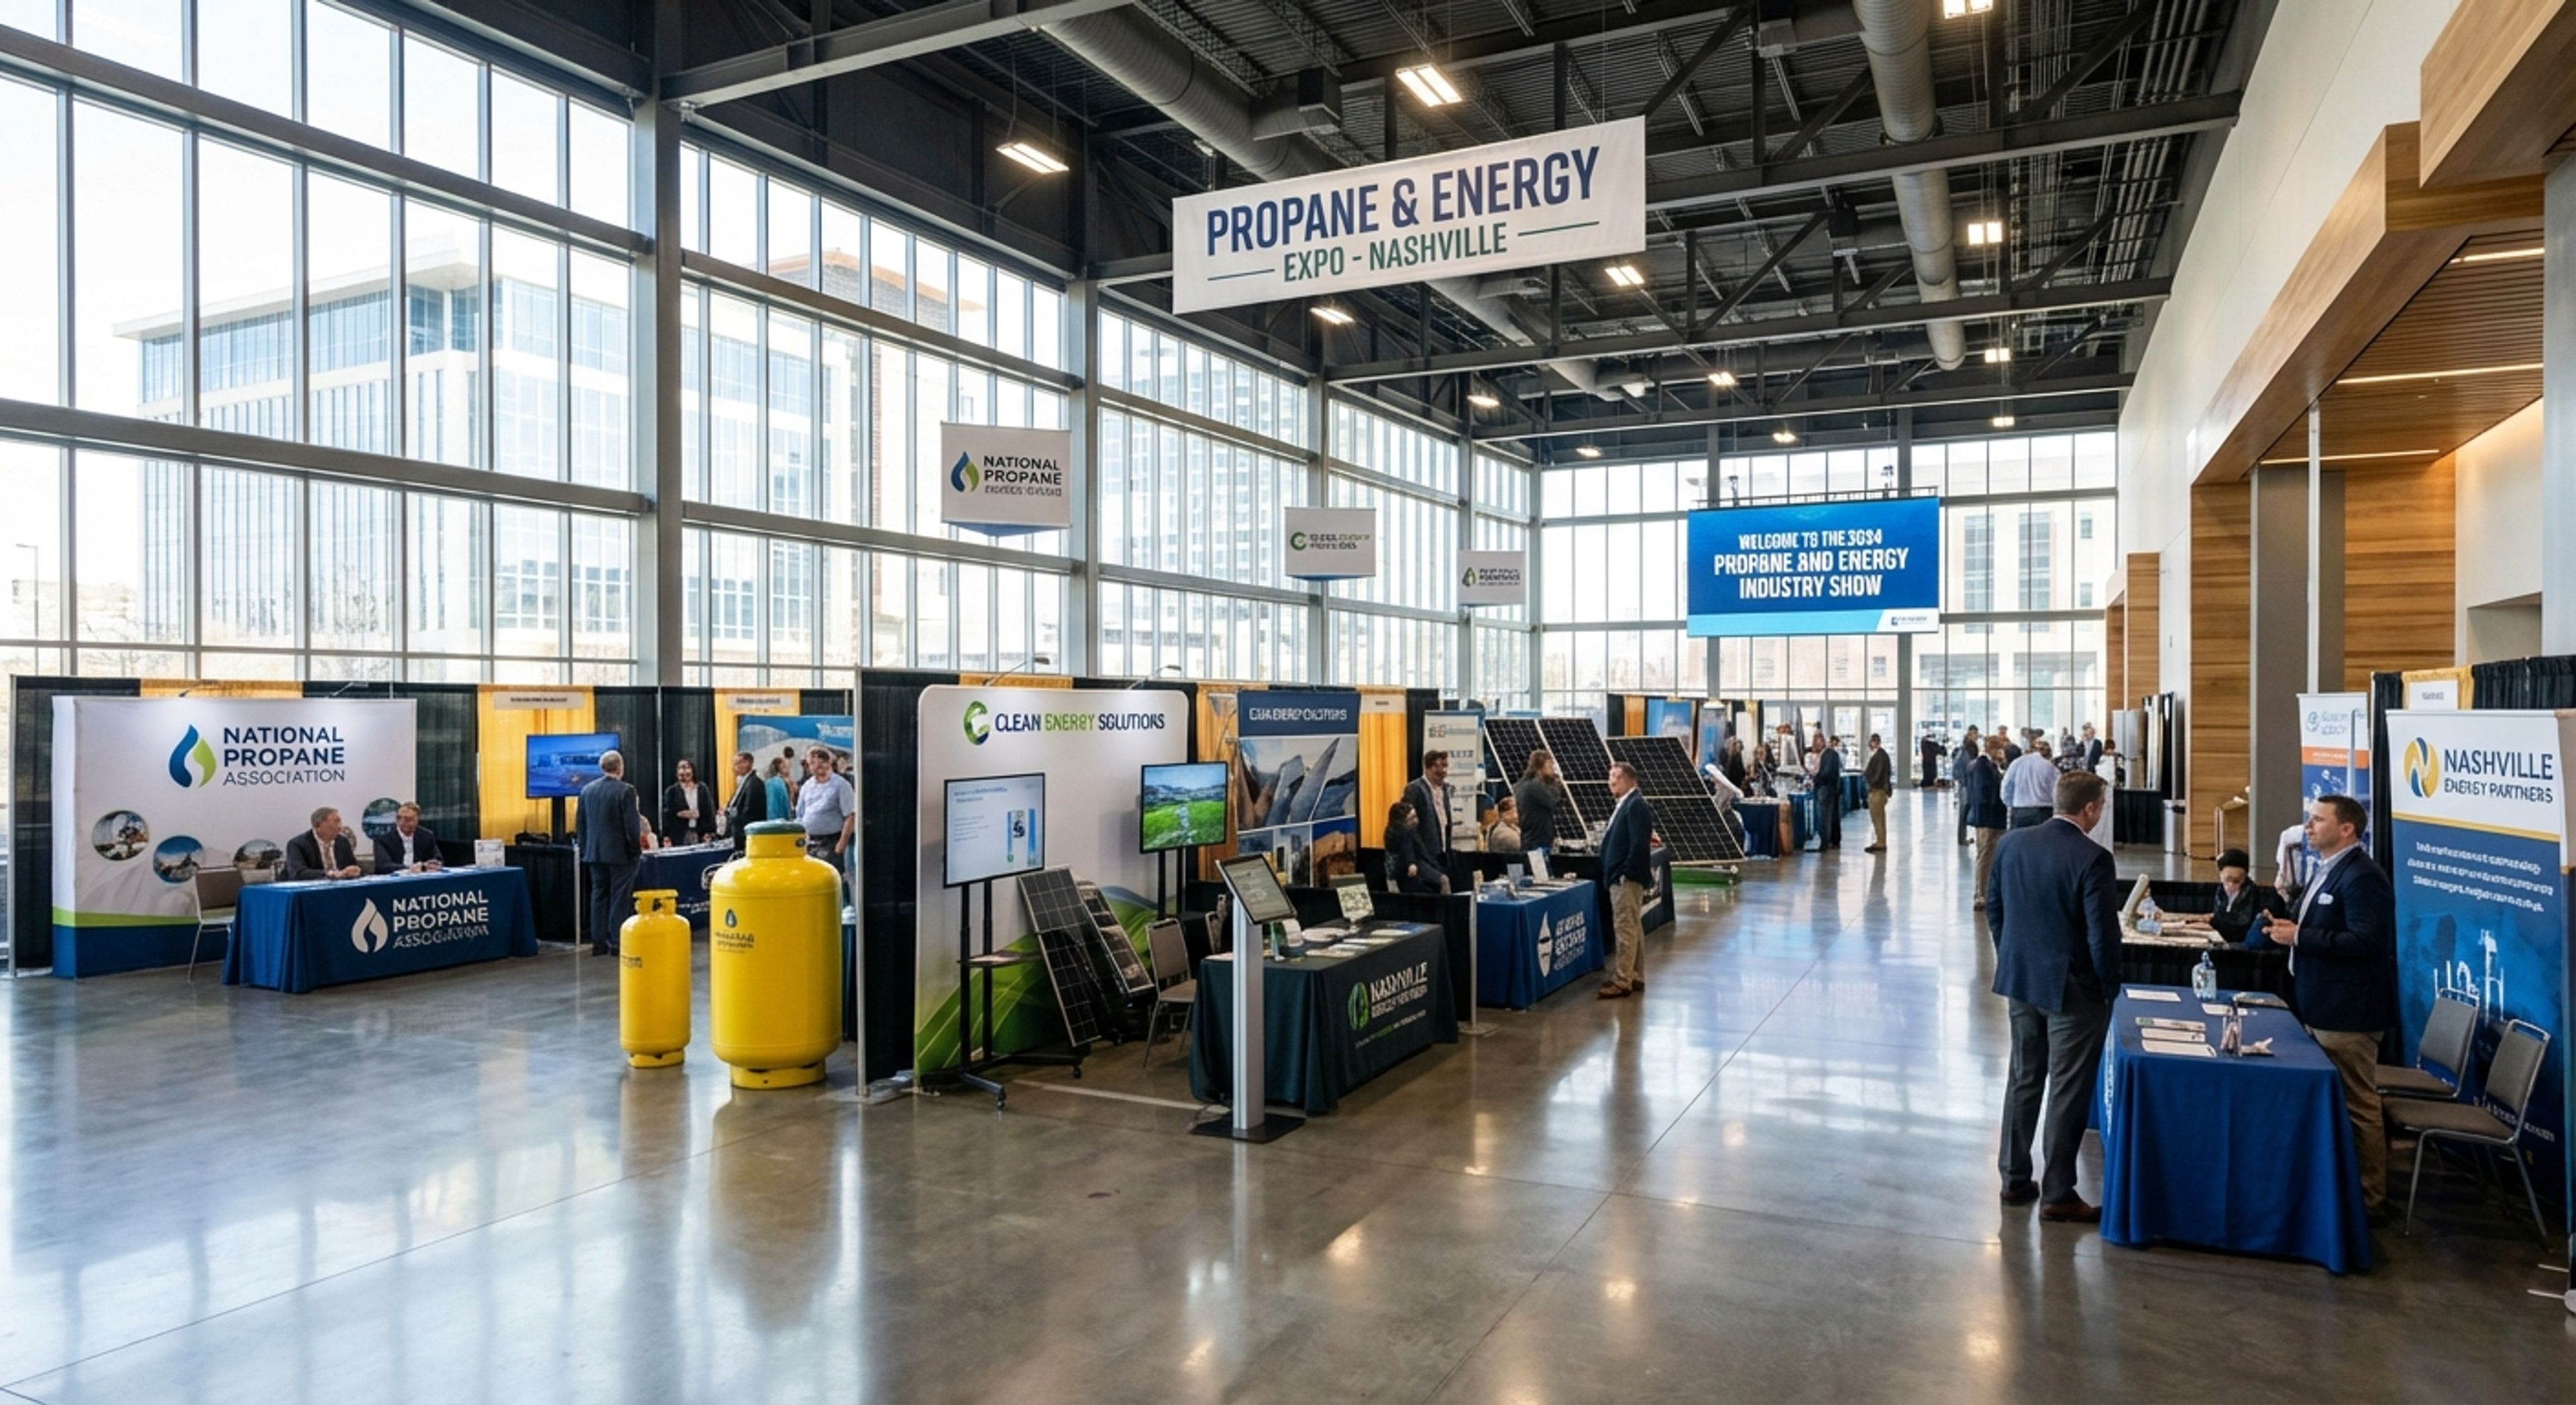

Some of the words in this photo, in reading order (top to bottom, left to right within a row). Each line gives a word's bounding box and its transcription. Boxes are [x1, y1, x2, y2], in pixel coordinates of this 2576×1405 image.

[1208, 183, 1378, 256] PROPANE
[1392, 178, 1419, 228] &
[1432, 146, 1600, 222] ENERGY
[1284, 246, 1343, 282] EXPO
[1369, 223, 1507, 271] NASHVILLE
[983, 455, 1061, 471] NATIONAL
[984, 470, 1062, 486] PROPANE
[1838, 547, 1909, 570] ENERGY
[1739, 575, 1825, 599] INDUSTRY
[1829, 574, 1882, 597] SHOW
[995, 713, 1041, 732] CLEAN
[224, 726, 344, 744] NATIONAL
[224, 747, 344, 767] PROPANE
[2444, 748, 2553, 781] NASHVILLE
[223, 769, 345, 786] ASSOCIATION
[392, 889, 489, 913] NATIONAL
